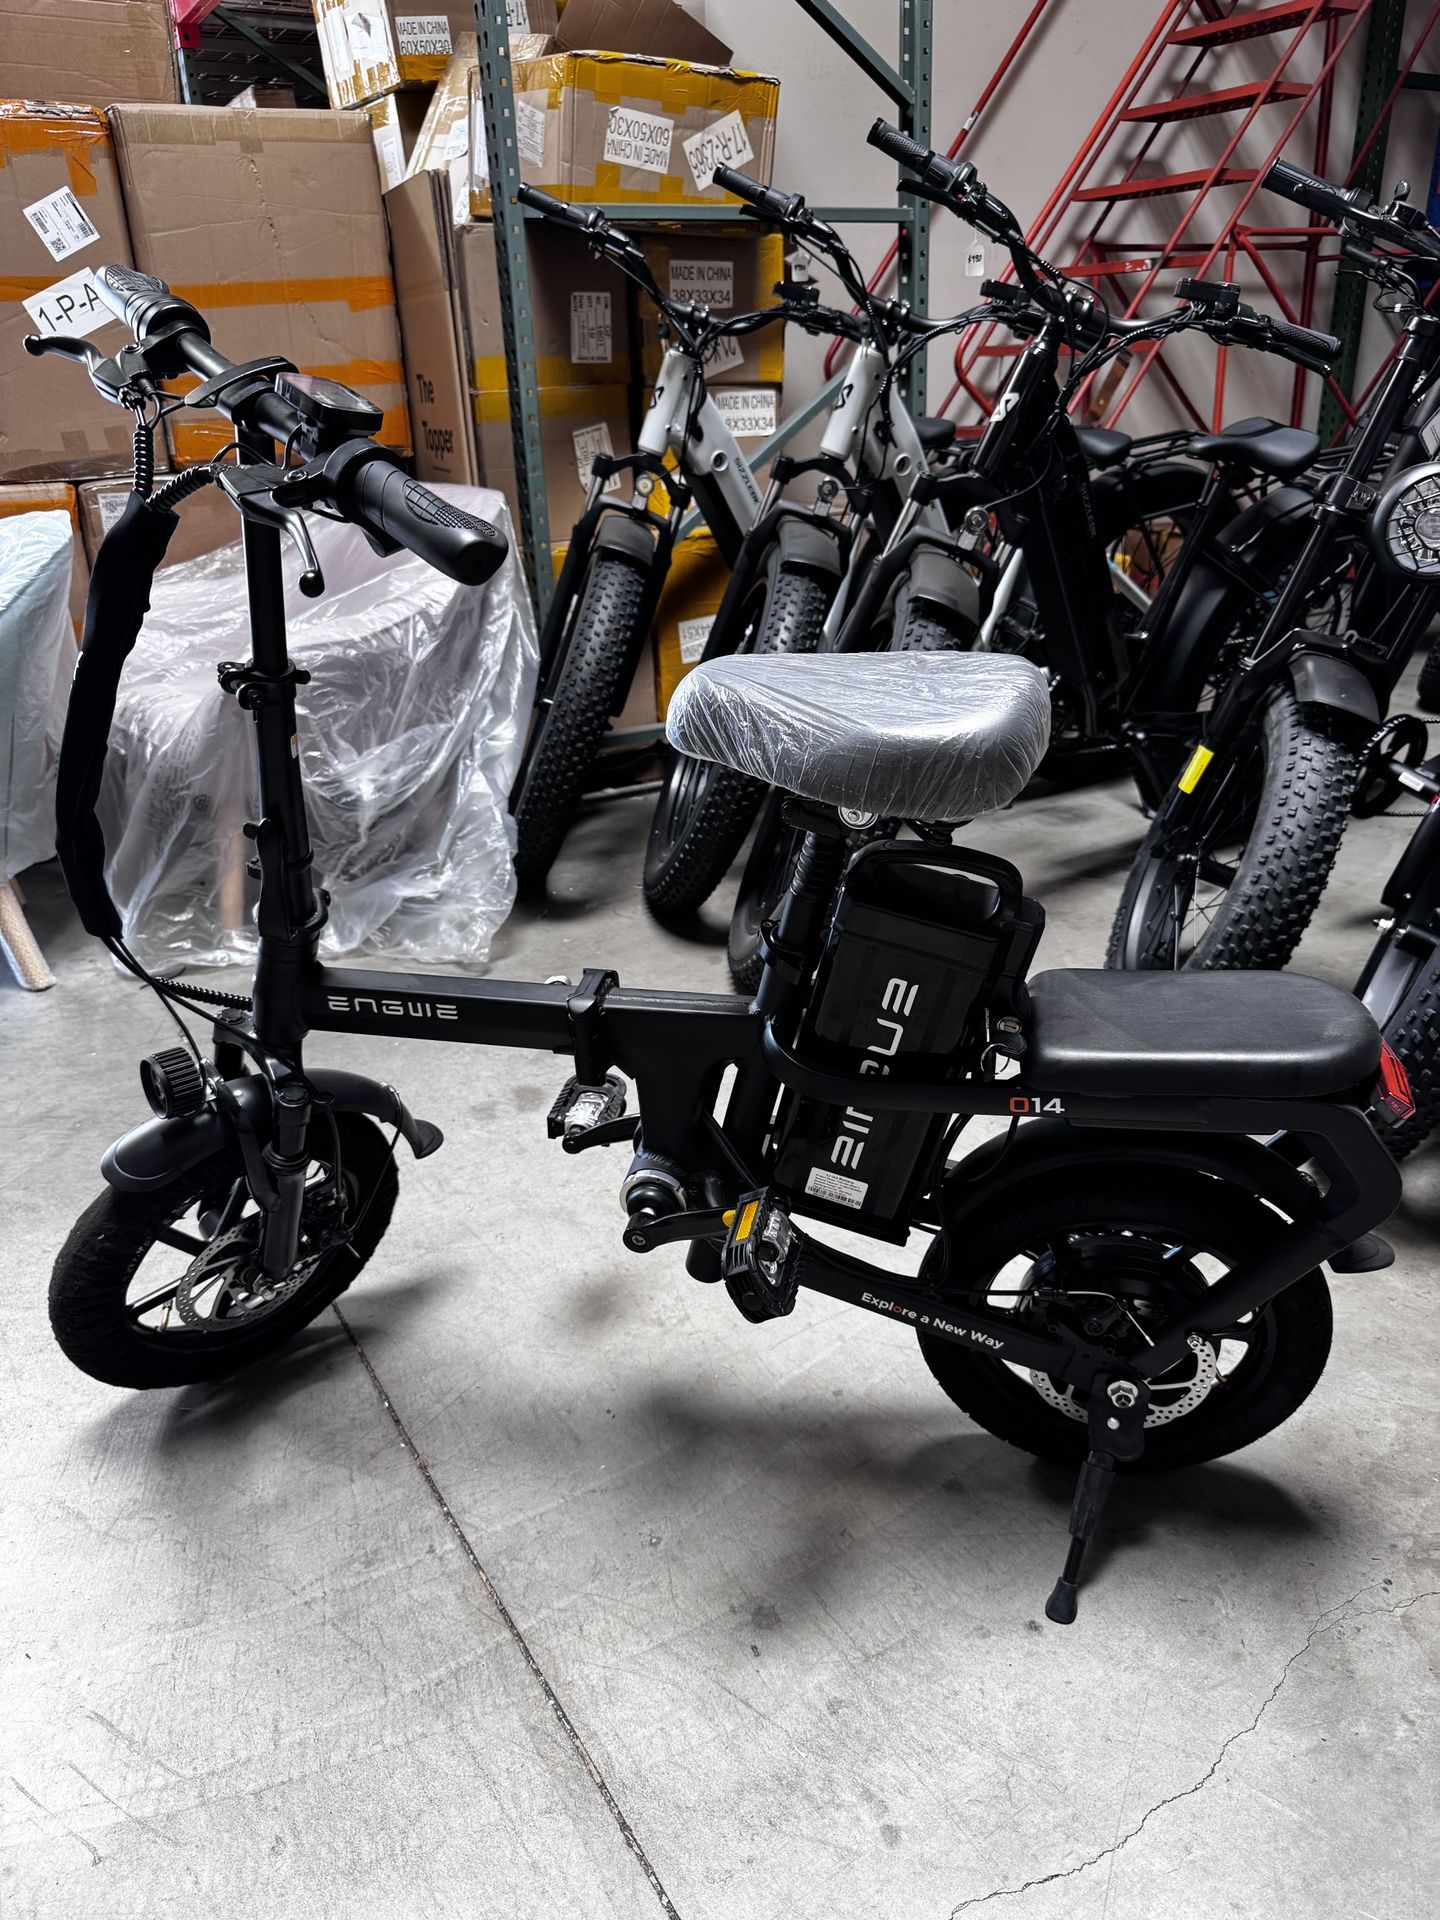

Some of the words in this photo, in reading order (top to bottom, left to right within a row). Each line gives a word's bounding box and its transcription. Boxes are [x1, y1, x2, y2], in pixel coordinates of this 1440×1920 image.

[397, 22, 418, 35] MADE
[418, 21, 426, 35] IN
[426, 21, 449, 35] CHINA
[610, 115, 670, 147] 60X50X30
[607, 138, 633, 160] CHINA
[633, 144, 643, 161] IN
[644, 147, 668, 168] MADE
[671, 266, 694, 280] MADE
[696, 266, 705, 280] IN
[707, 266, 731, 281] CHINA
[416, 374, 435, 404] The
[741, 396, 750, 409] IN
[751, 395, 773, 409] CHINA
[422, 421, 453, 460] Topper
[327, 995, 459, 1020] ENGWE
[861, 1292, 917, 1319] Explore
[920, 1315, 930, 1324] a
[933, 1317, 967, 1336] New
[970, 1330, 1005, 1350] Way
